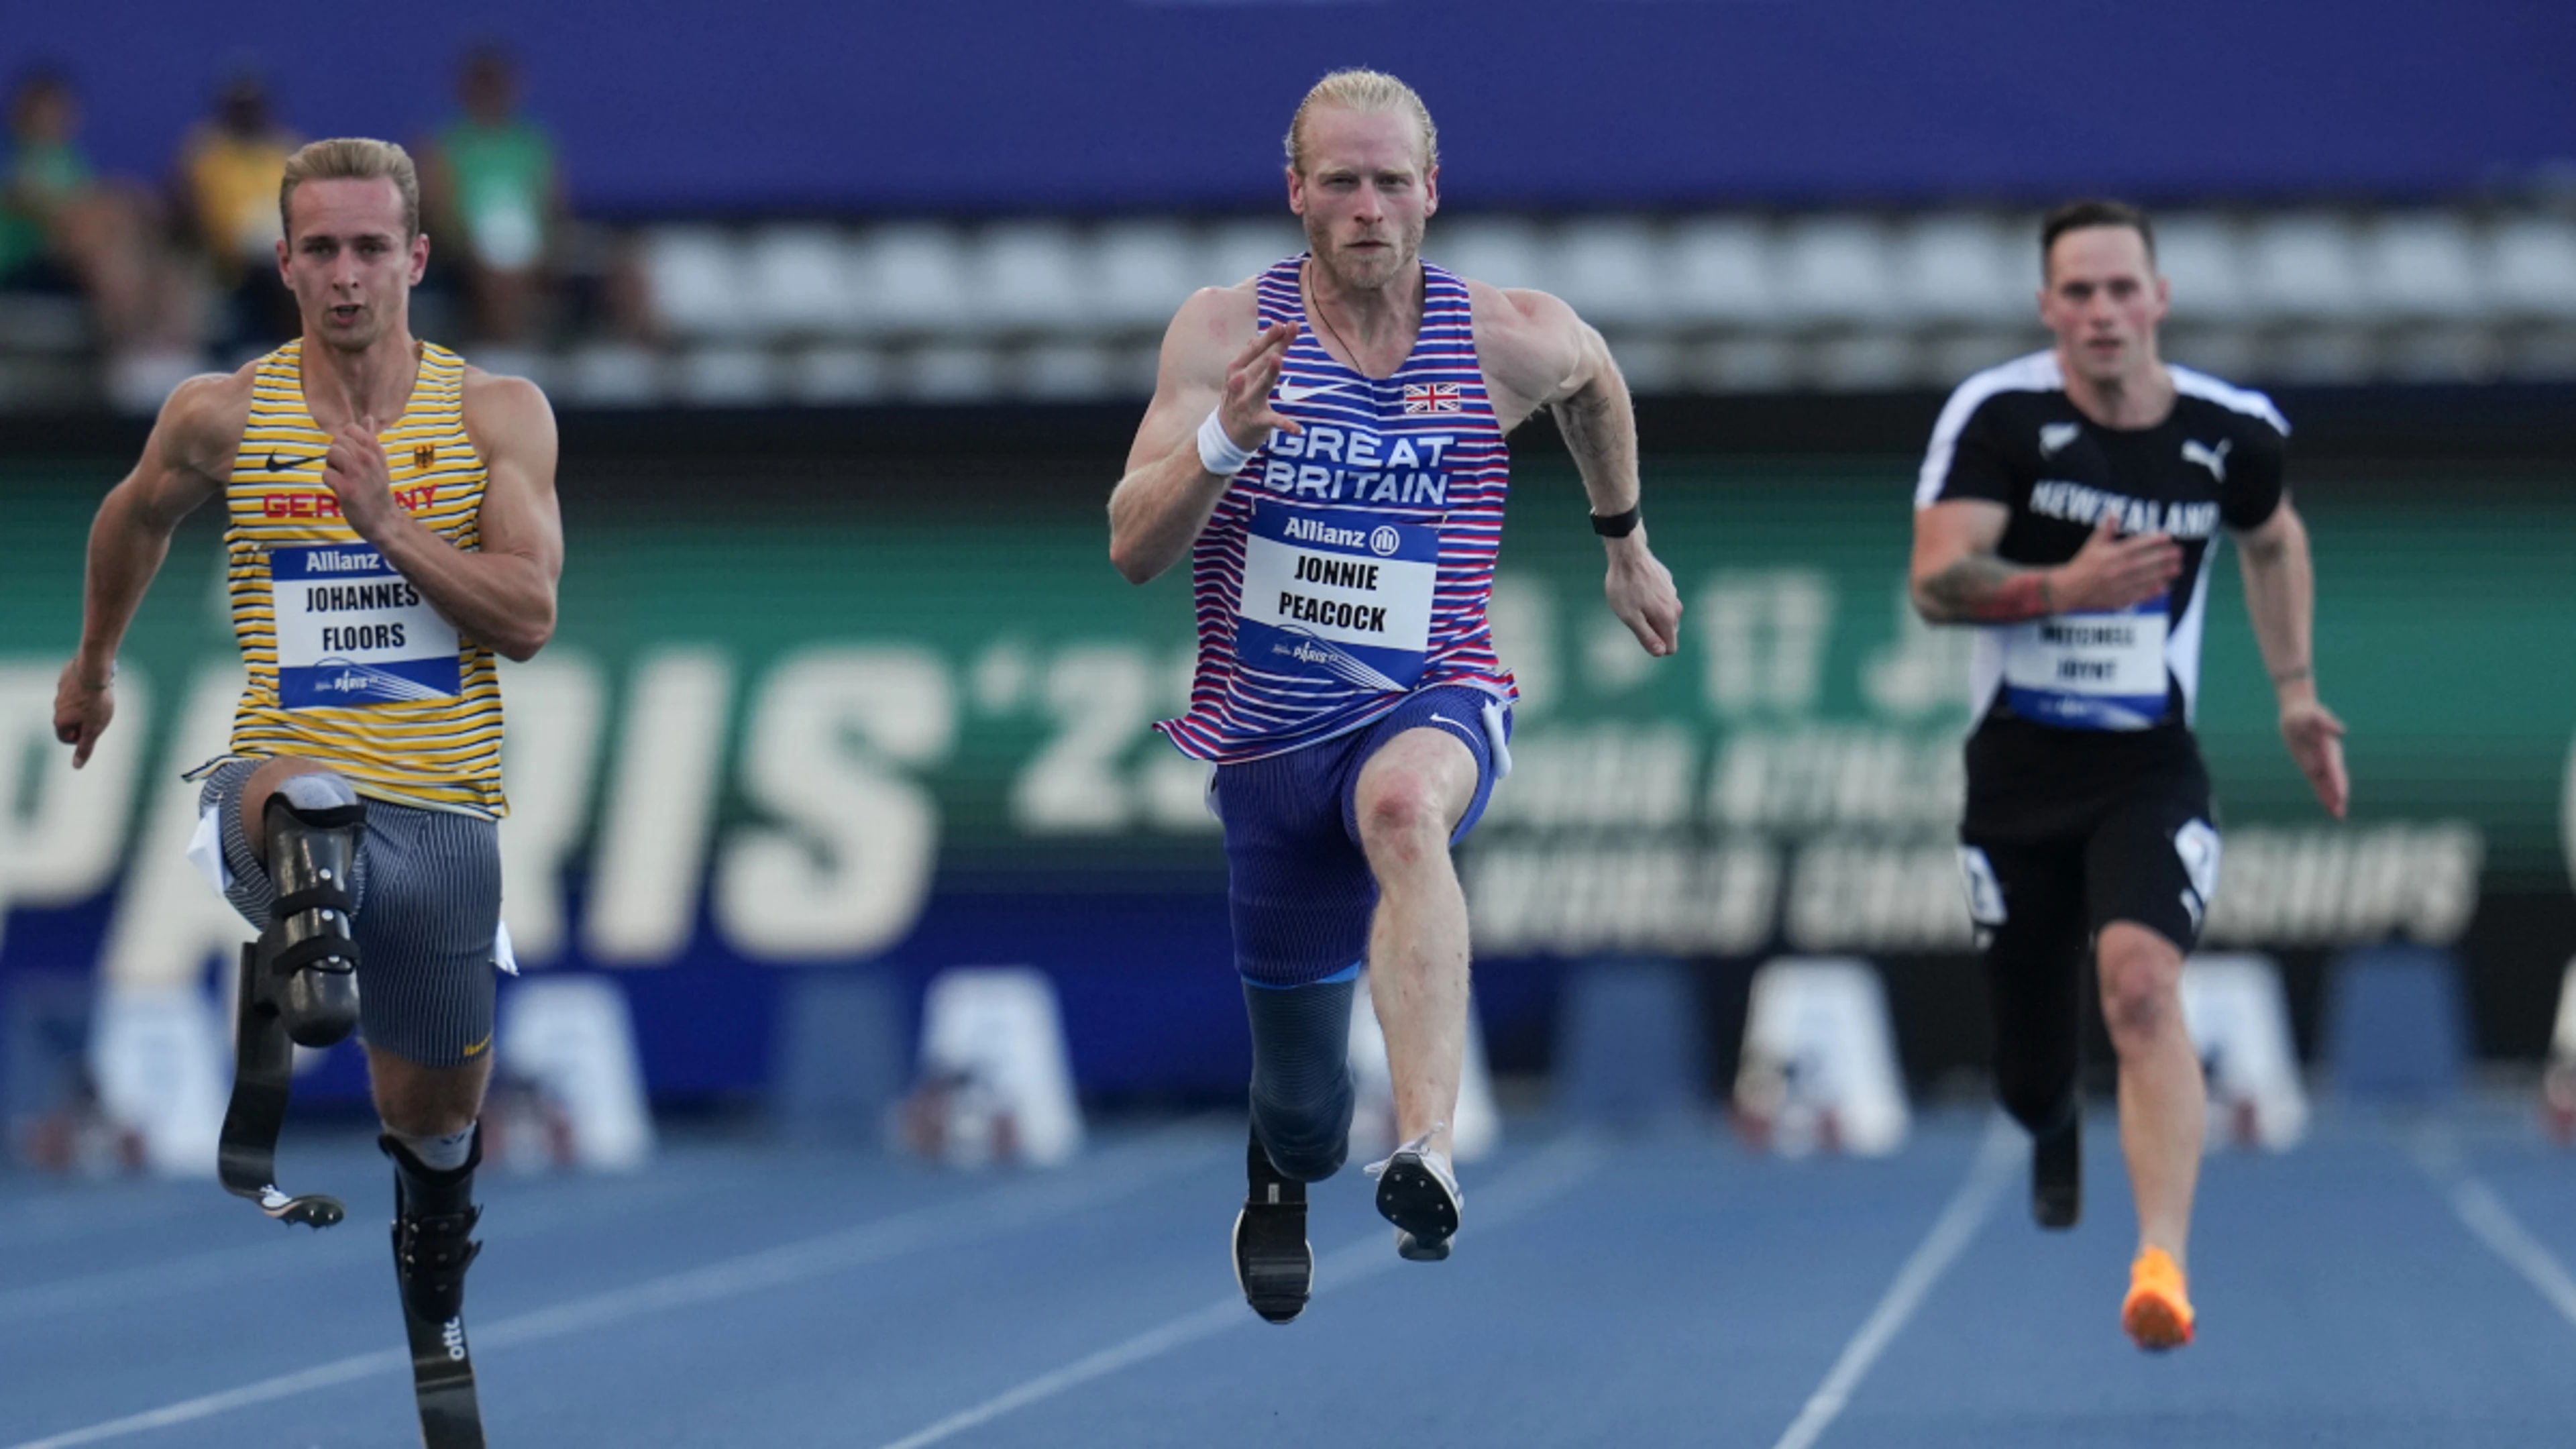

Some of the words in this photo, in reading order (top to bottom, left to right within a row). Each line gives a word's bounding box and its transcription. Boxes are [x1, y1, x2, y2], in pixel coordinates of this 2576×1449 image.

[1270, 425, 1454, 468] GREAT
[1264, 459, 1448, 505] BRITAIN
[264, 484, 440, 519] GERNY
[1284, 517, 1365, 549] Allianz
[306, 550, 380, 572] Allianz
[1295, 555, 1379, 591] JONNIE
[306, 582, 420, 612] JOHANNES
[1279, 592, 1387, 633] PEACOCK
[323, 623, 406, 651] FLOORS
[0, 644, 965, 965] PIS
